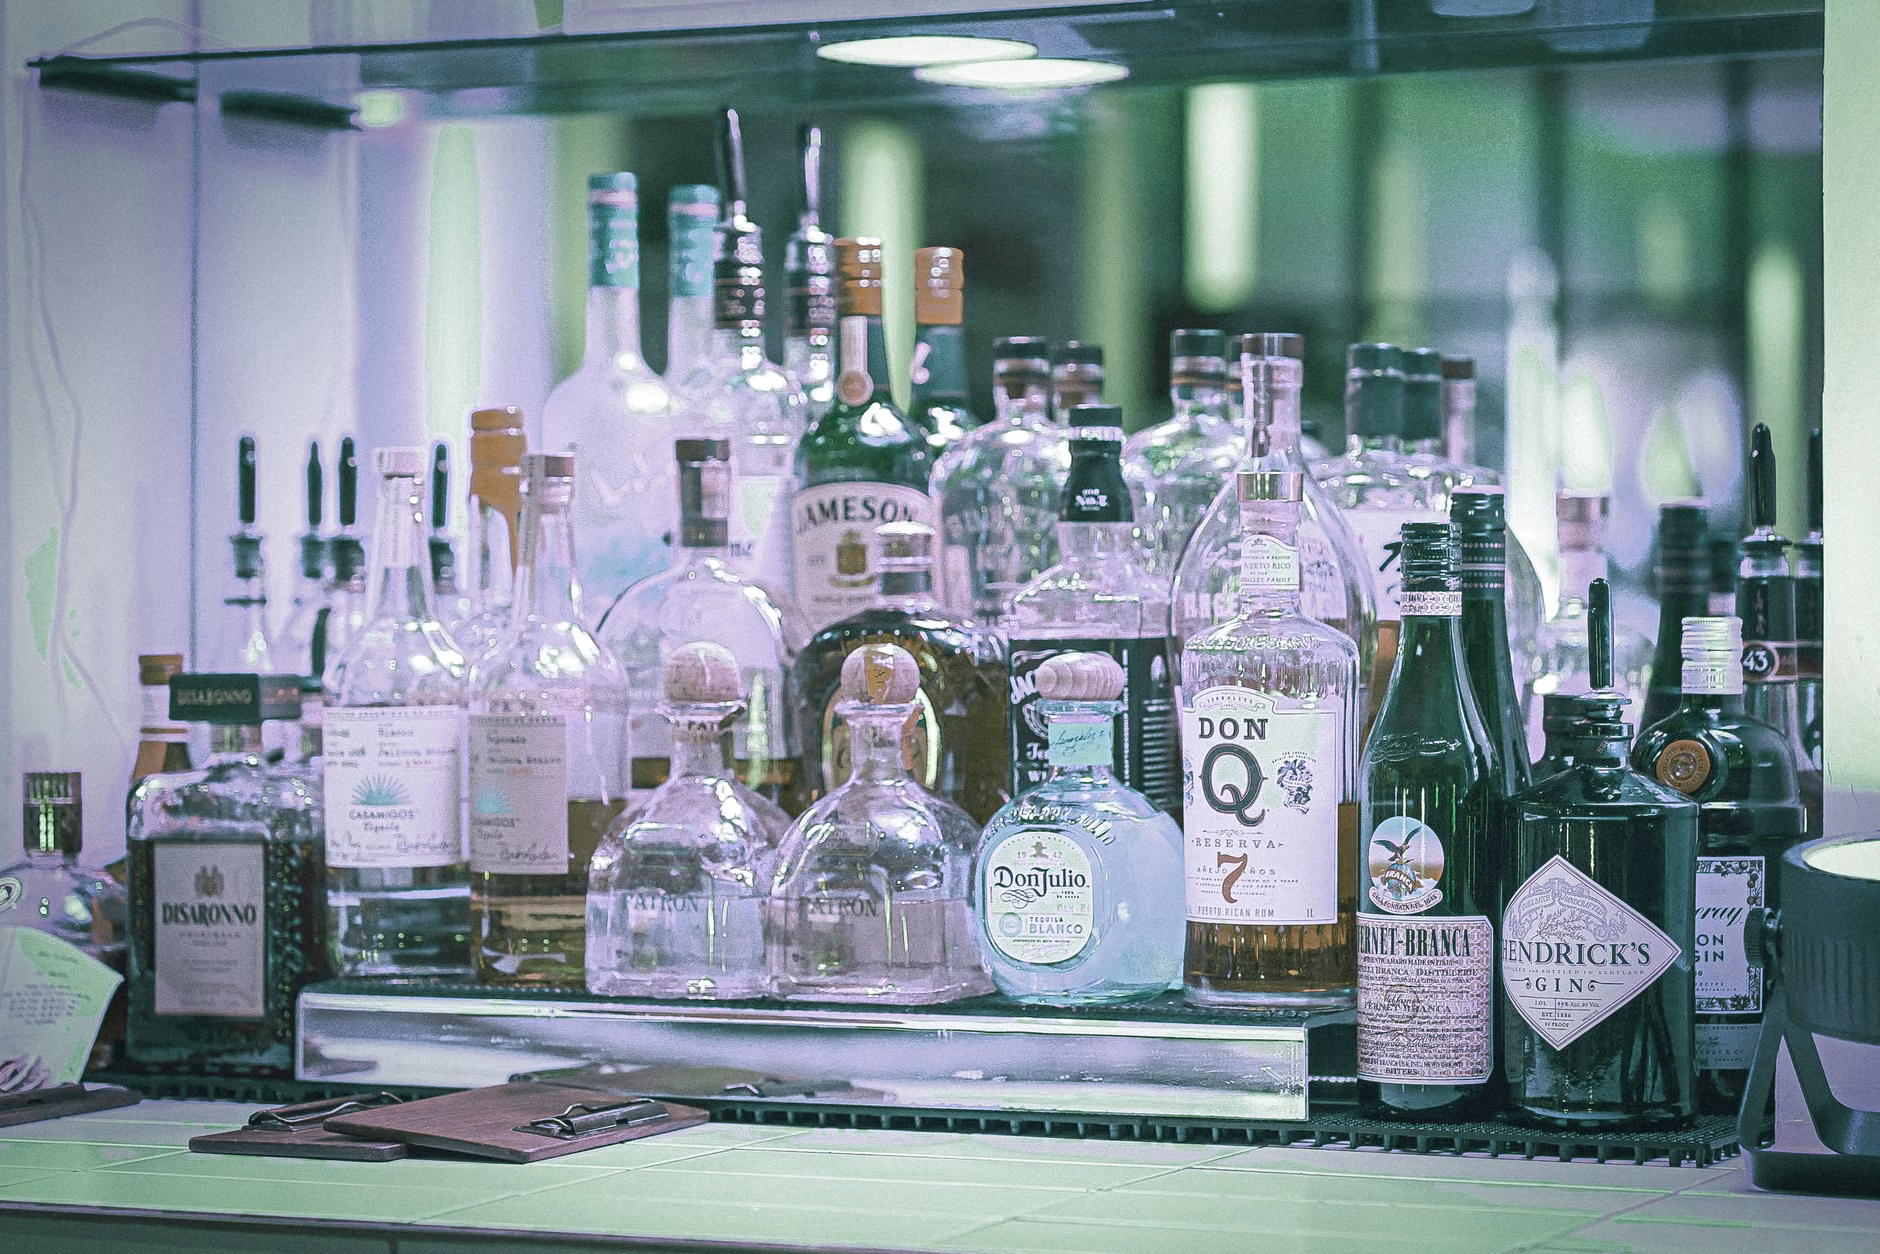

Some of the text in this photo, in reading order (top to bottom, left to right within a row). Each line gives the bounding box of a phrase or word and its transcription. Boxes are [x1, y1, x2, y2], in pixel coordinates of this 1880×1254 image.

[1743, 651, 1769, 672] 43
[1198, 717, 1269, 740] DON
[1199, 743, 1269, 827] Q
[1196, 838, 1276, 849] RESERVA
[1197, 866, 1228, 874] AÑEJO
[1217, 851, 1248, 904] 7
[162, 902, 257, 927] DISARONNO
[1198, 906, 1222, 917] PUERTO
[1225, 908, 1251, 918] RICAN
[1254, 909, 1275, 918] RUM
[1029, 924, 1083, 934] BLANCO
[1374, 966, 1409, 976] BRANCA
[1535, 976, 1584, 993] GIN
[1385, 1067, 1419, 1075] BITTERS
